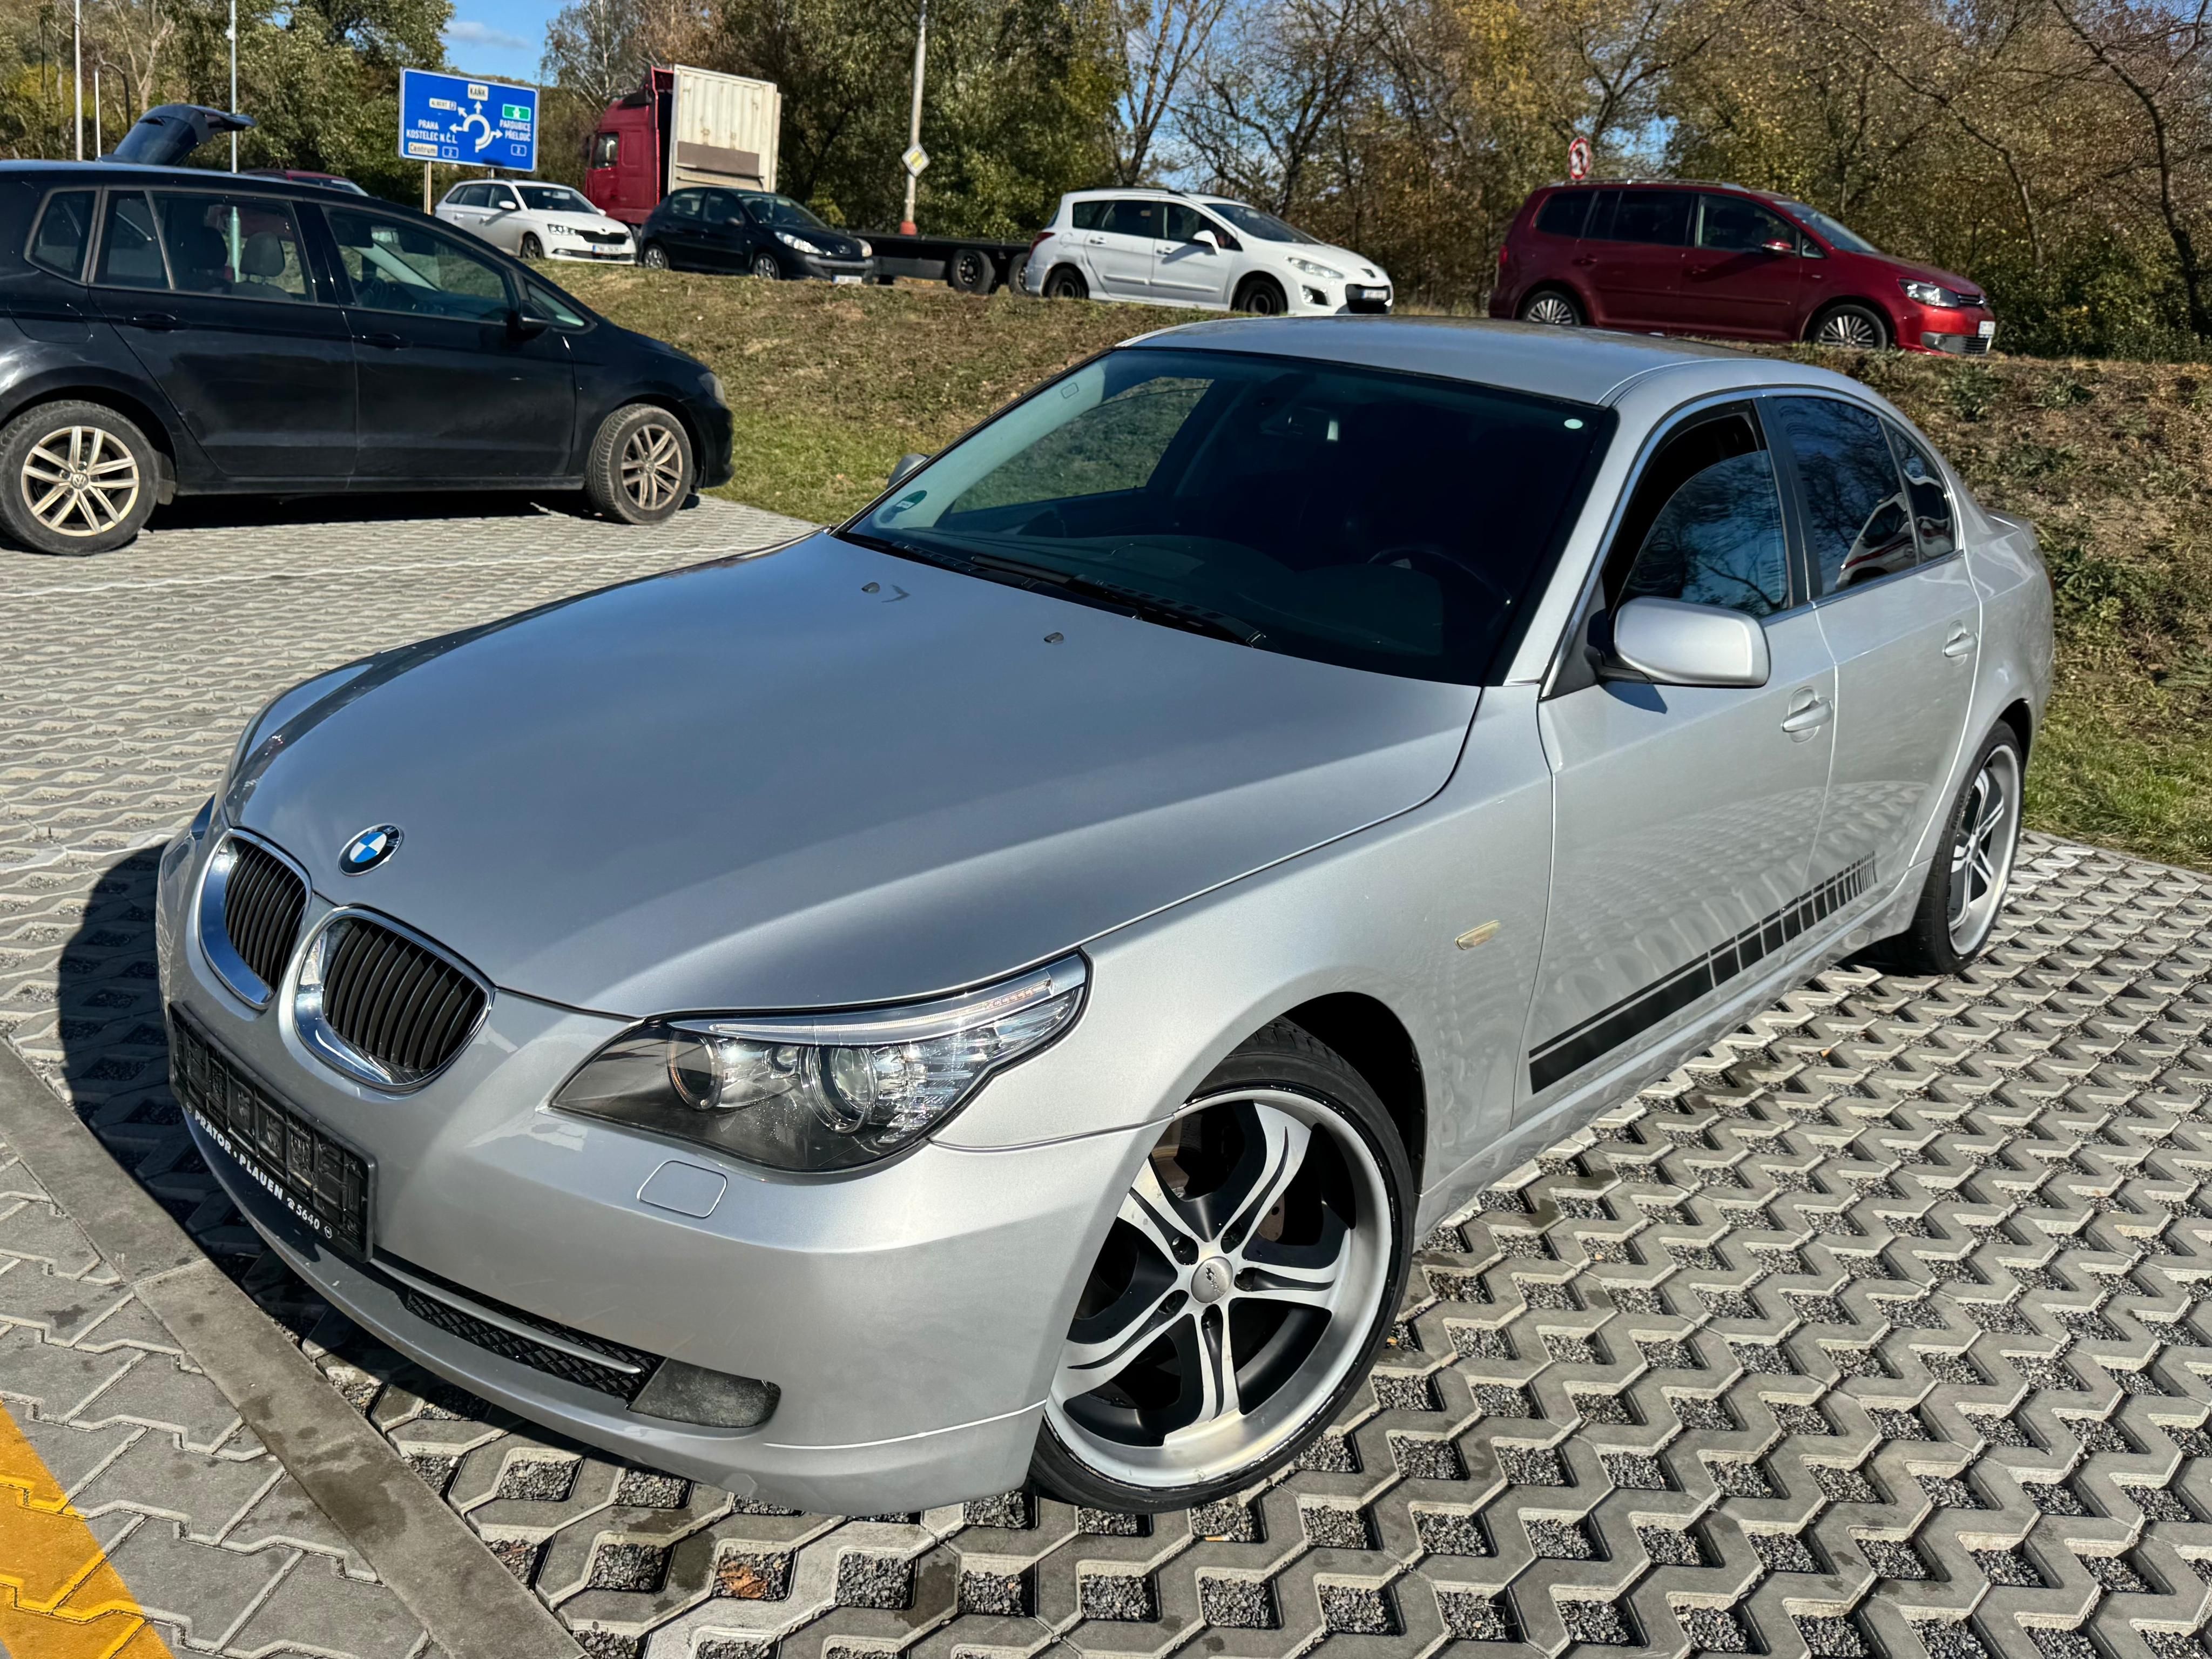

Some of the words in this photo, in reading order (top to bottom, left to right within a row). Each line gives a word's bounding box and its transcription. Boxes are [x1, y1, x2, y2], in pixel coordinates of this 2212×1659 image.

[417, 119, 439, 130] PRAHA
[406, 129, 439, 142] KOSTELEC
[410, 143, 436, 154] Centrum
[448, 149, 454, 157] 2
[194, 1109, 232, 1154] PRÄTOR
[239, 1153, 284, 1201] PLAUEN
[296, 1204, 320, 1230] 5640
